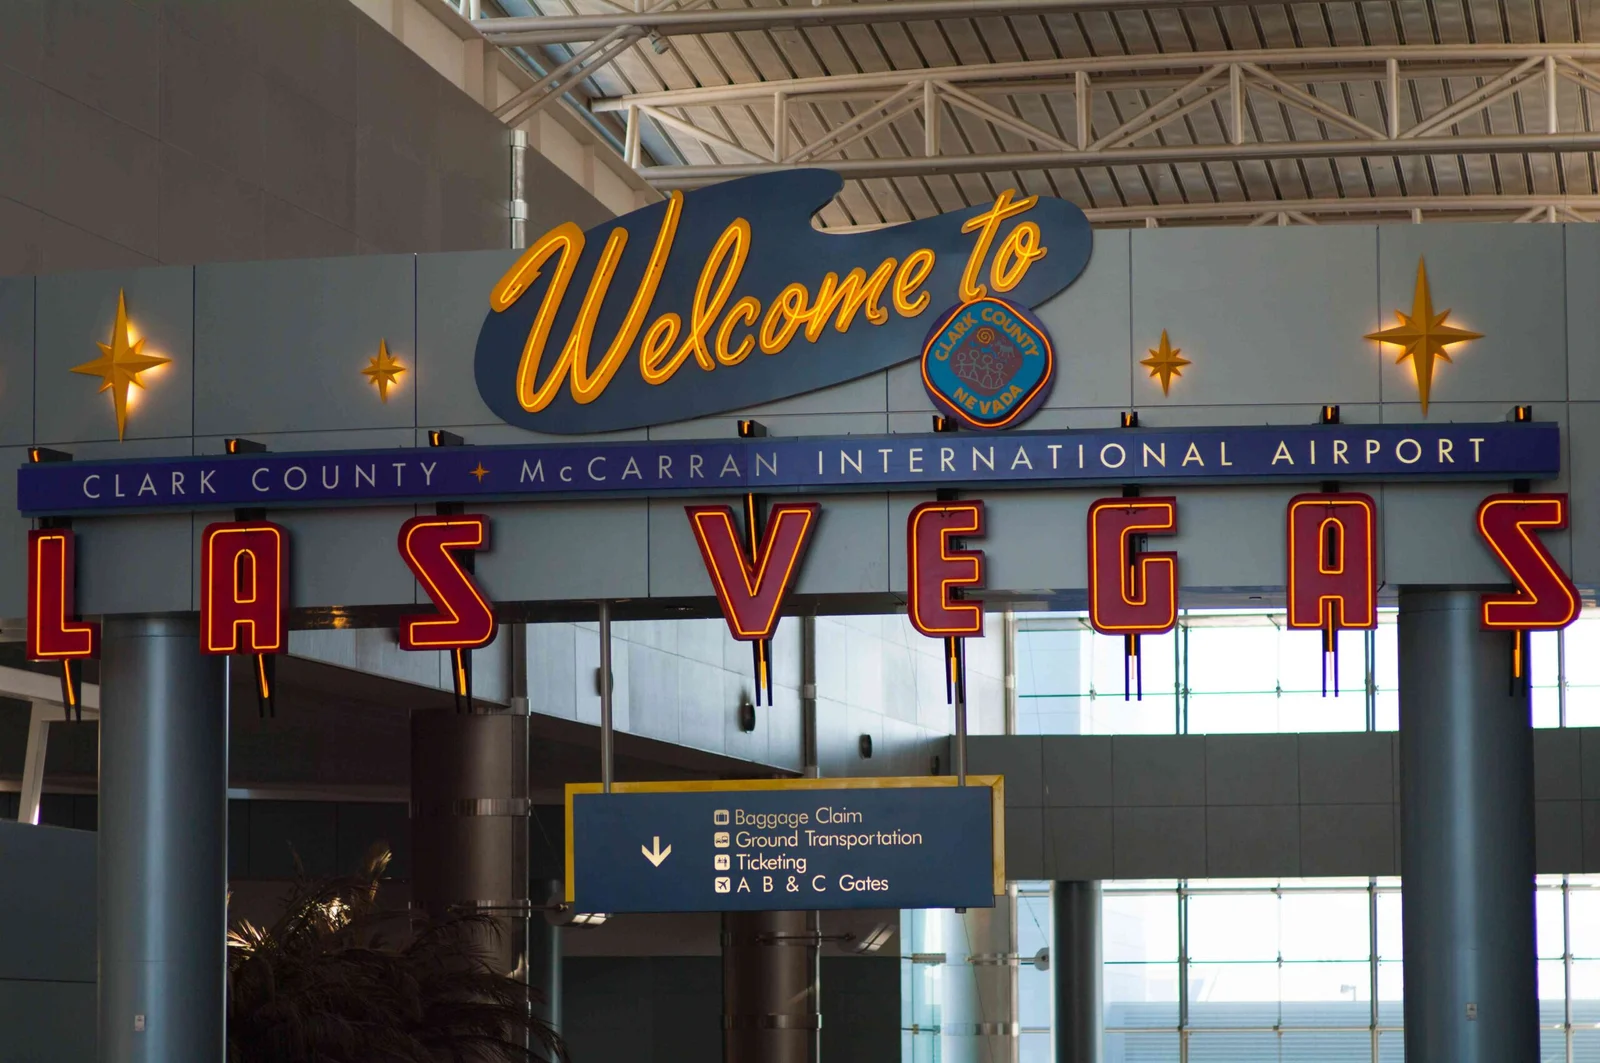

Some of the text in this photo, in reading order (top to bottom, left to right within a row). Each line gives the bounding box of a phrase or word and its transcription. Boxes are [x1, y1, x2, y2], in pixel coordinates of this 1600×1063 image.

[489, 188, 1047, 412] Welcome to
[935, 308, 1039, 361] CLARK COUNTY
[953, 384, 1023, 415] NEVADA
[82, 437, 1486, 499] CLARK COUNTY McCARRAN INTERNATIONAL AIRPORT
[27, 493, 1582, 661] LAS VEGAS
[736, 807, 863, 828] Baggage Claim
[735, 829, 922, 849] Ground Transportation
[736, 853, 807, 874] Ticketing
[737, 874, 889, 893] A B & C Gates
